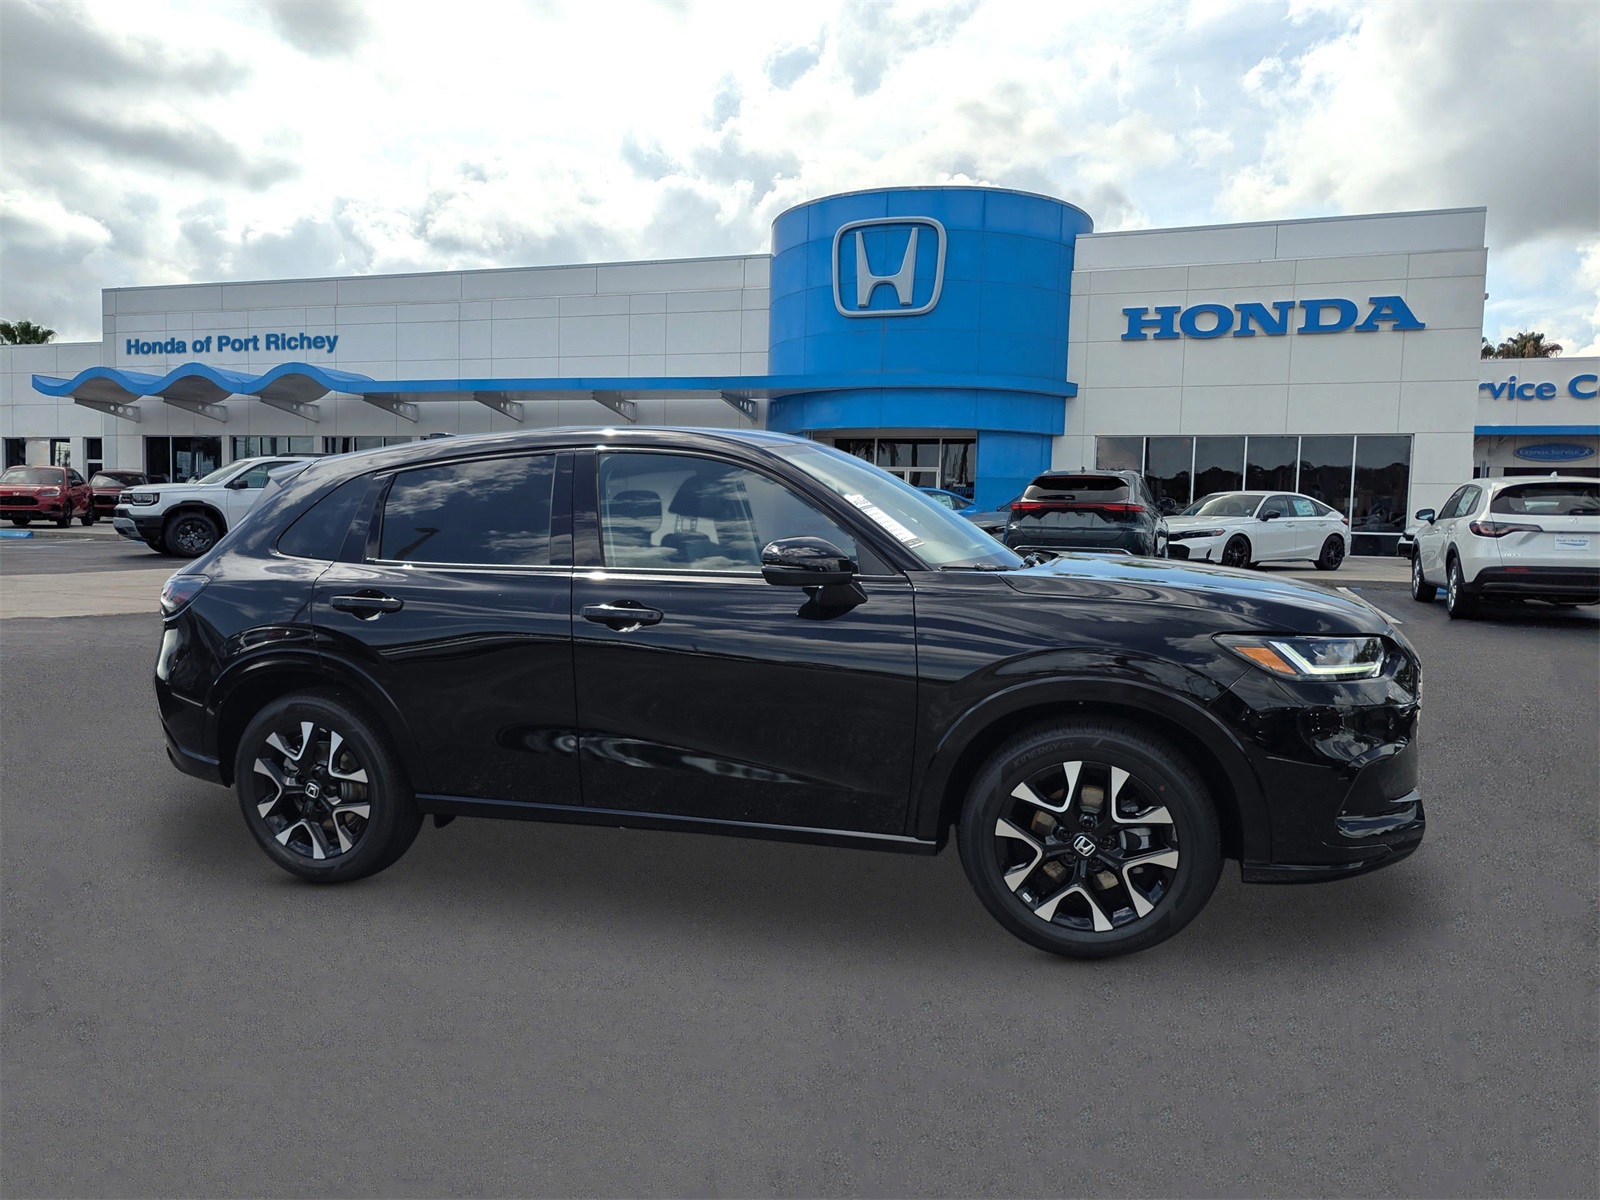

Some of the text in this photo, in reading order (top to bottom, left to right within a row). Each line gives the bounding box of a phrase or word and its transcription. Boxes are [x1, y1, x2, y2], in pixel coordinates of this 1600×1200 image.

[1121, 295, 1425, 340] HONDA
[126, 333, 339, 355] Honda of Port Richey
[1567, 374, 1600, 400] C
